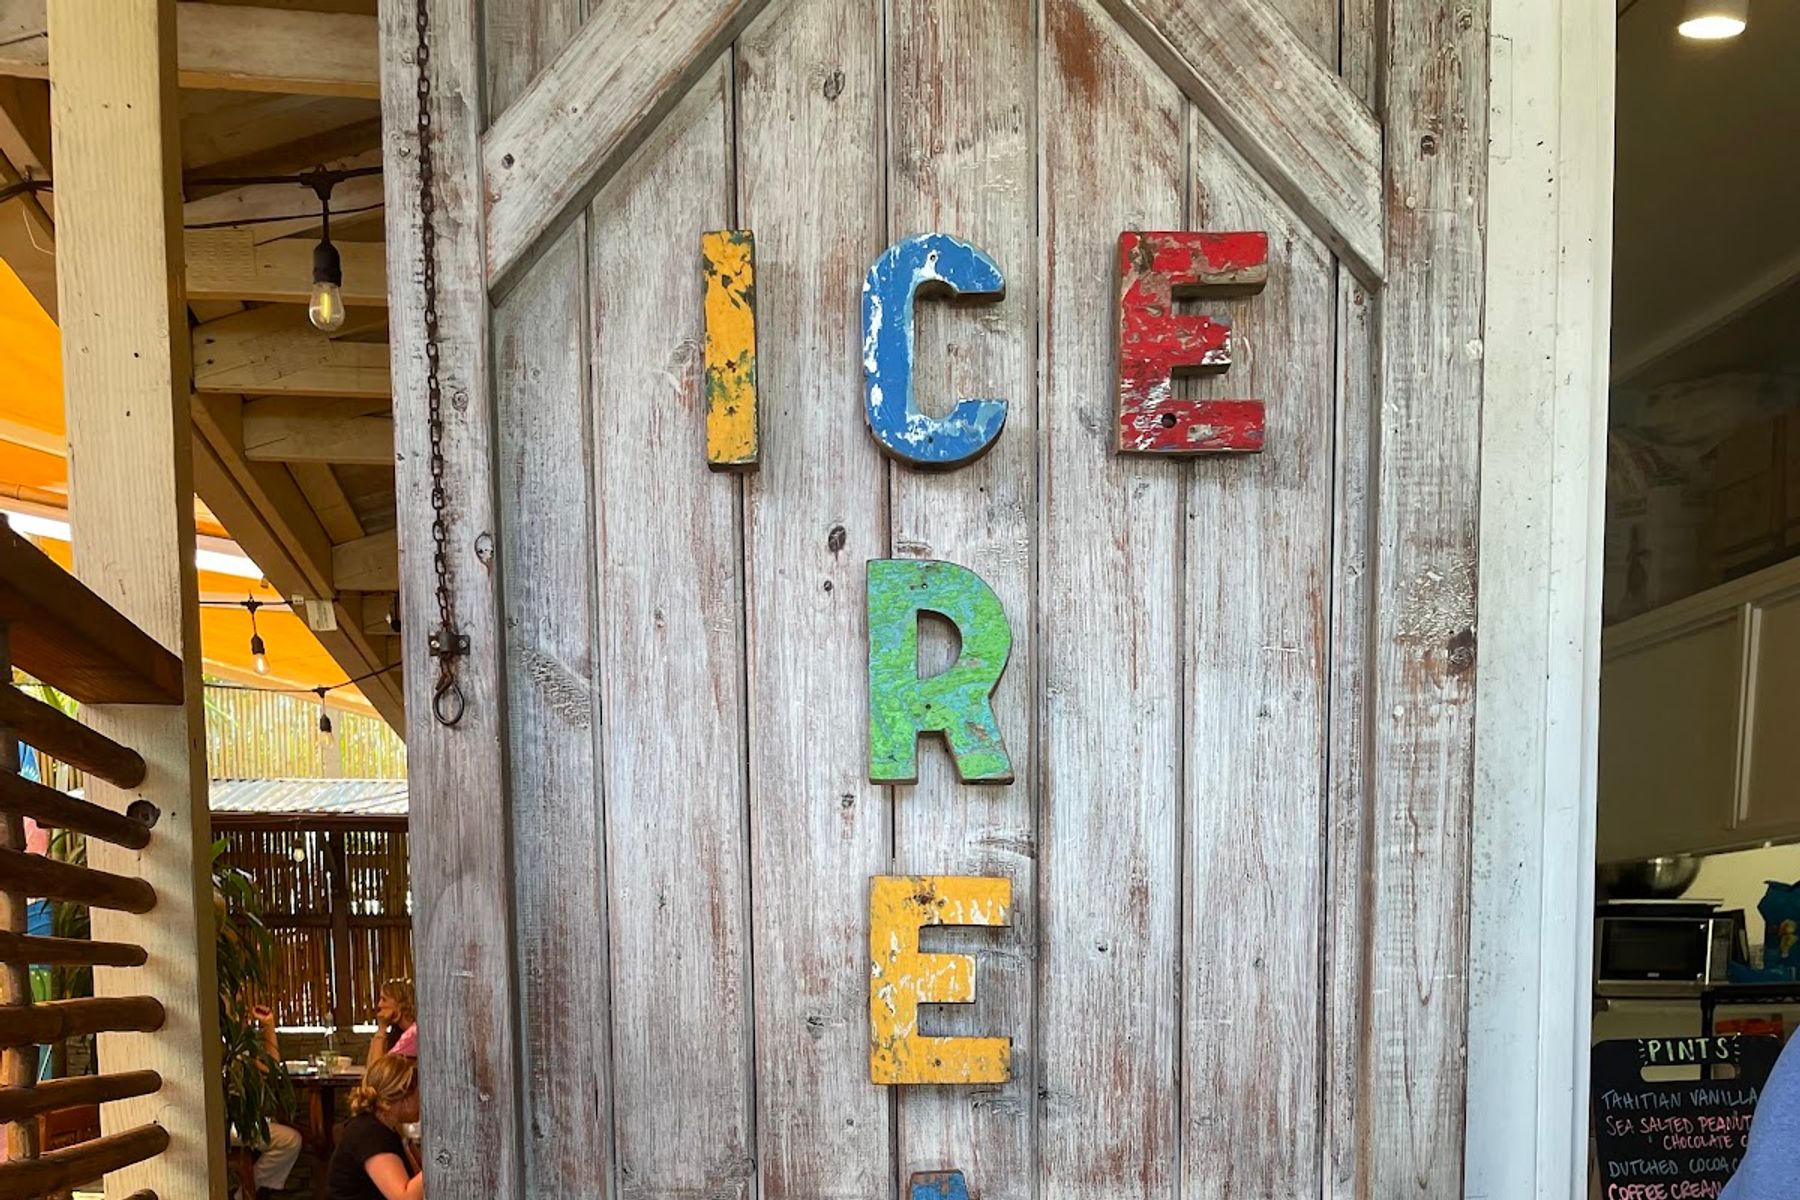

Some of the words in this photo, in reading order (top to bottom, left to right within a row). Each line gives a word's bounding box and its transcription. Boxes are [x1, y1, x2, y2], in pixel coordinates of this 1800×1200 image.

[702, 229, 1268, 472] ICE
[1647, 1037, 1729, 1061] PINTS
[1601, 1089, 1681, 1110] TAHITIAN
[1690, 1087, 1758, 1107] VANILLA
[1605, 1115, 1634, 1136] SEA
[1640, 1115, 1694, 1134] SALTED
[1698, 1112, 1752, 1134] PEANUT
[1663, 1134, 1734, 1150] CHOCOLATE
[1608, 1158, 1679, 1178] DUTCHED
[1689, 1156, 1729, 1174] COCOA
